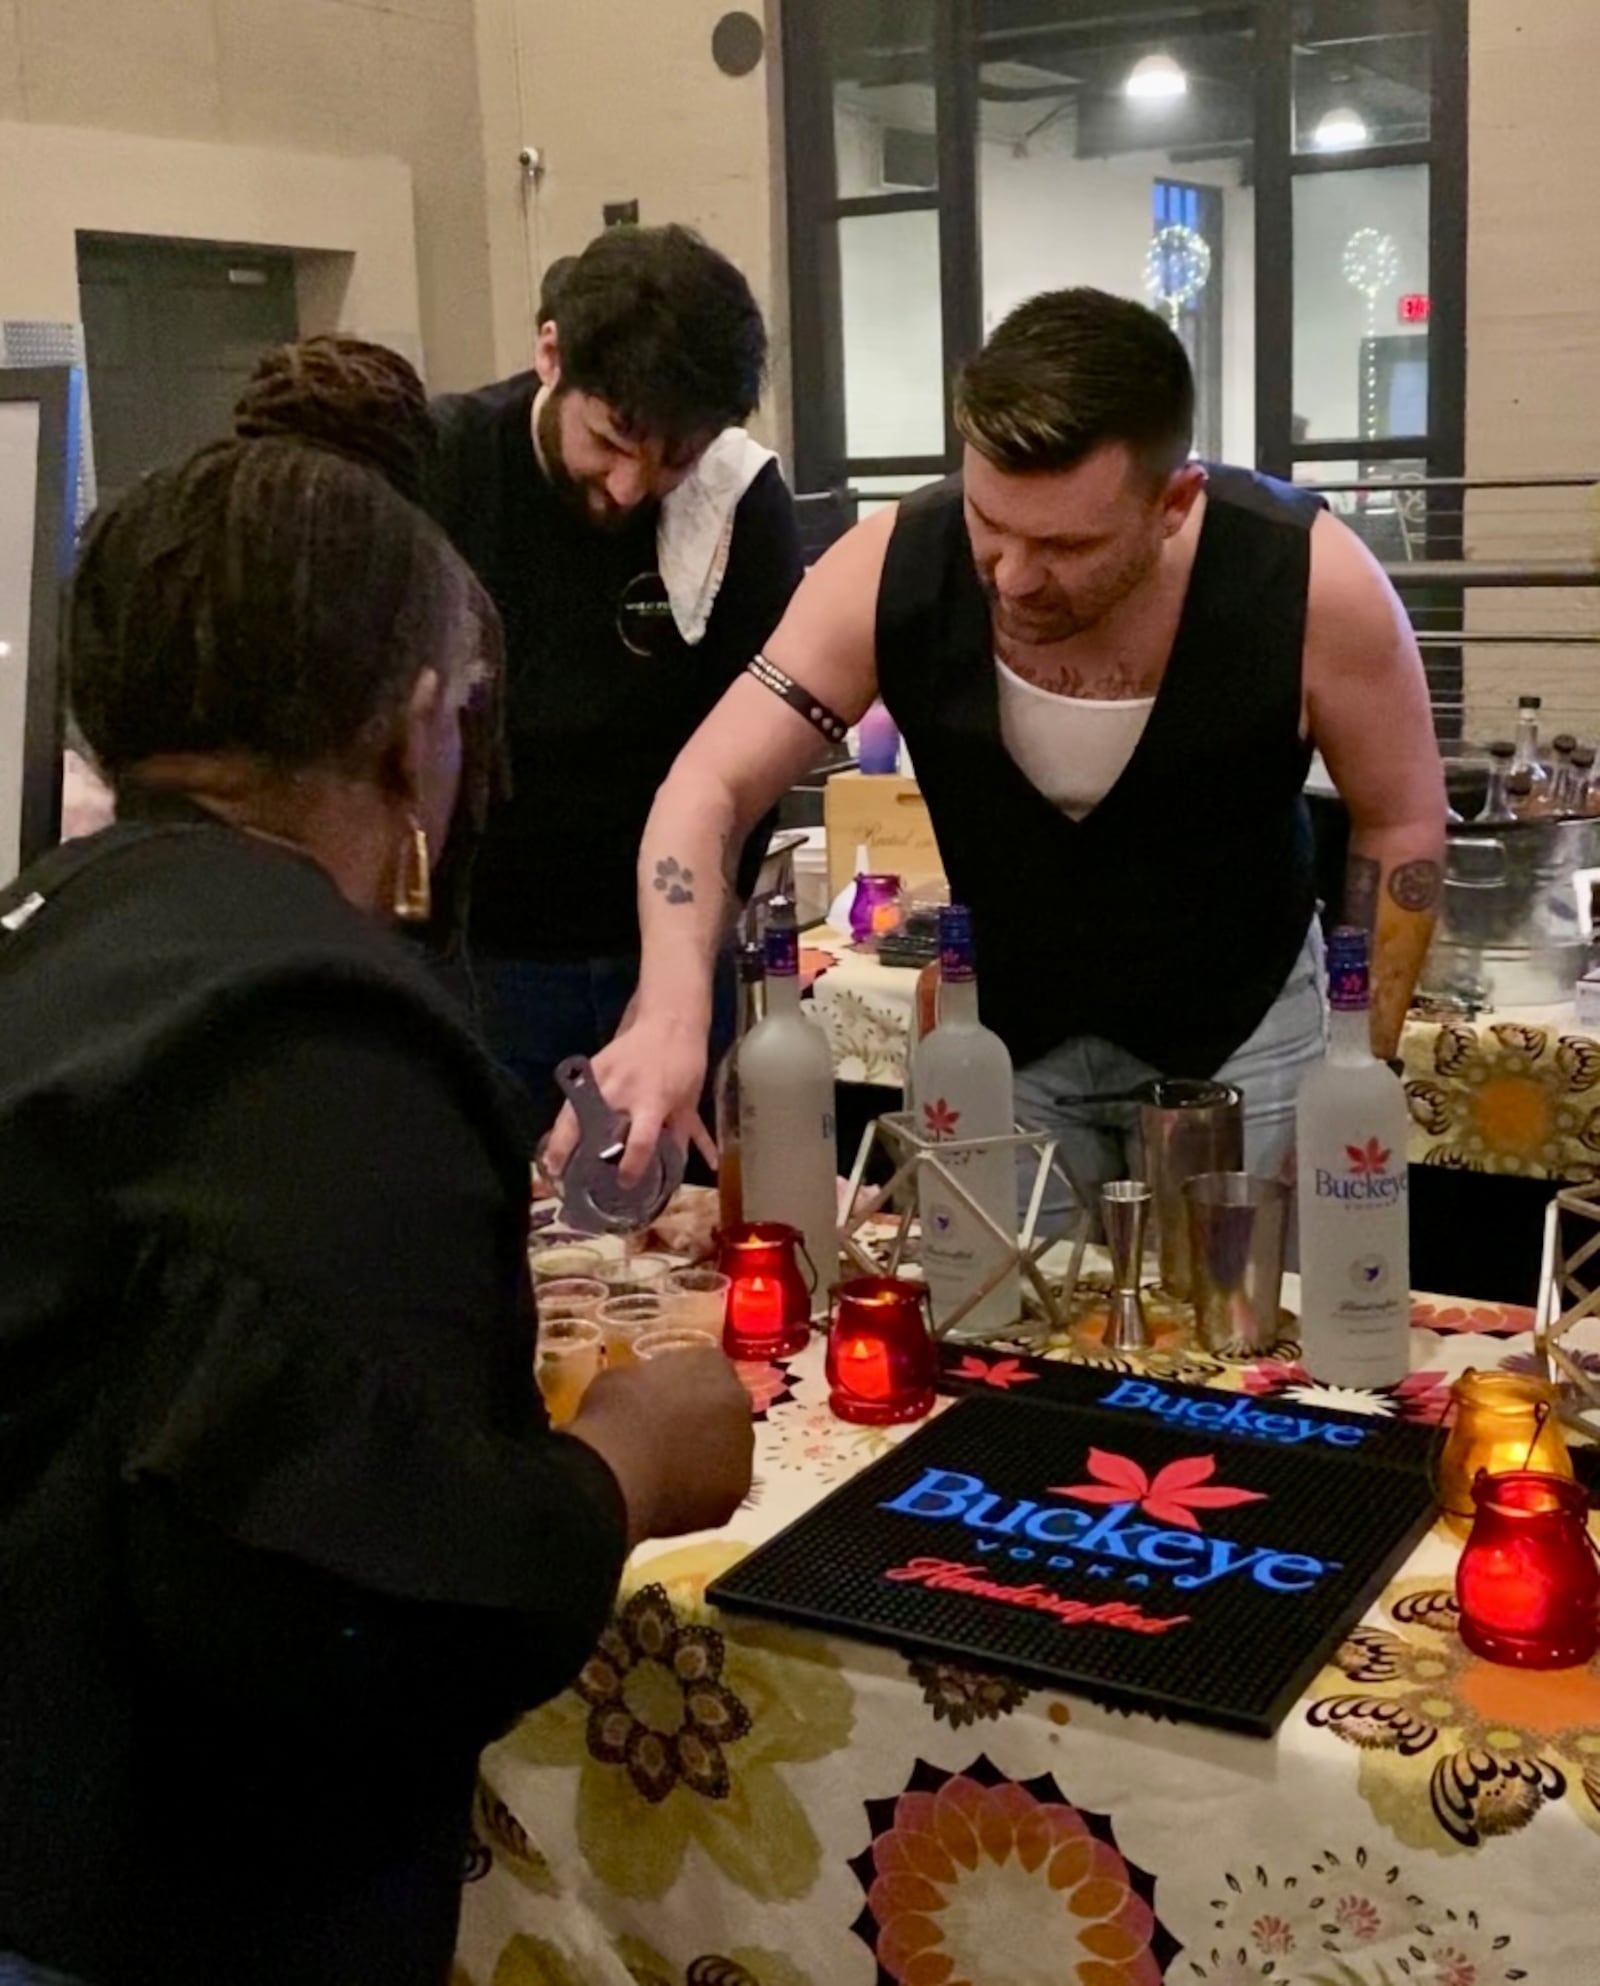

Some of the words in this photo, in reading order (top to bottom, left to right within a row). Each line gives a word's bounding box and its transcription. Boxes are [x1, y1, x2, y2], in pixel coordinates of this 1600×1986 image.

[1099, 1379, 1365, 1446] Buckeye
[876, 1467, 1324, 1590] Buckeye
[976, 1538, 1150, 1586] VODKA
